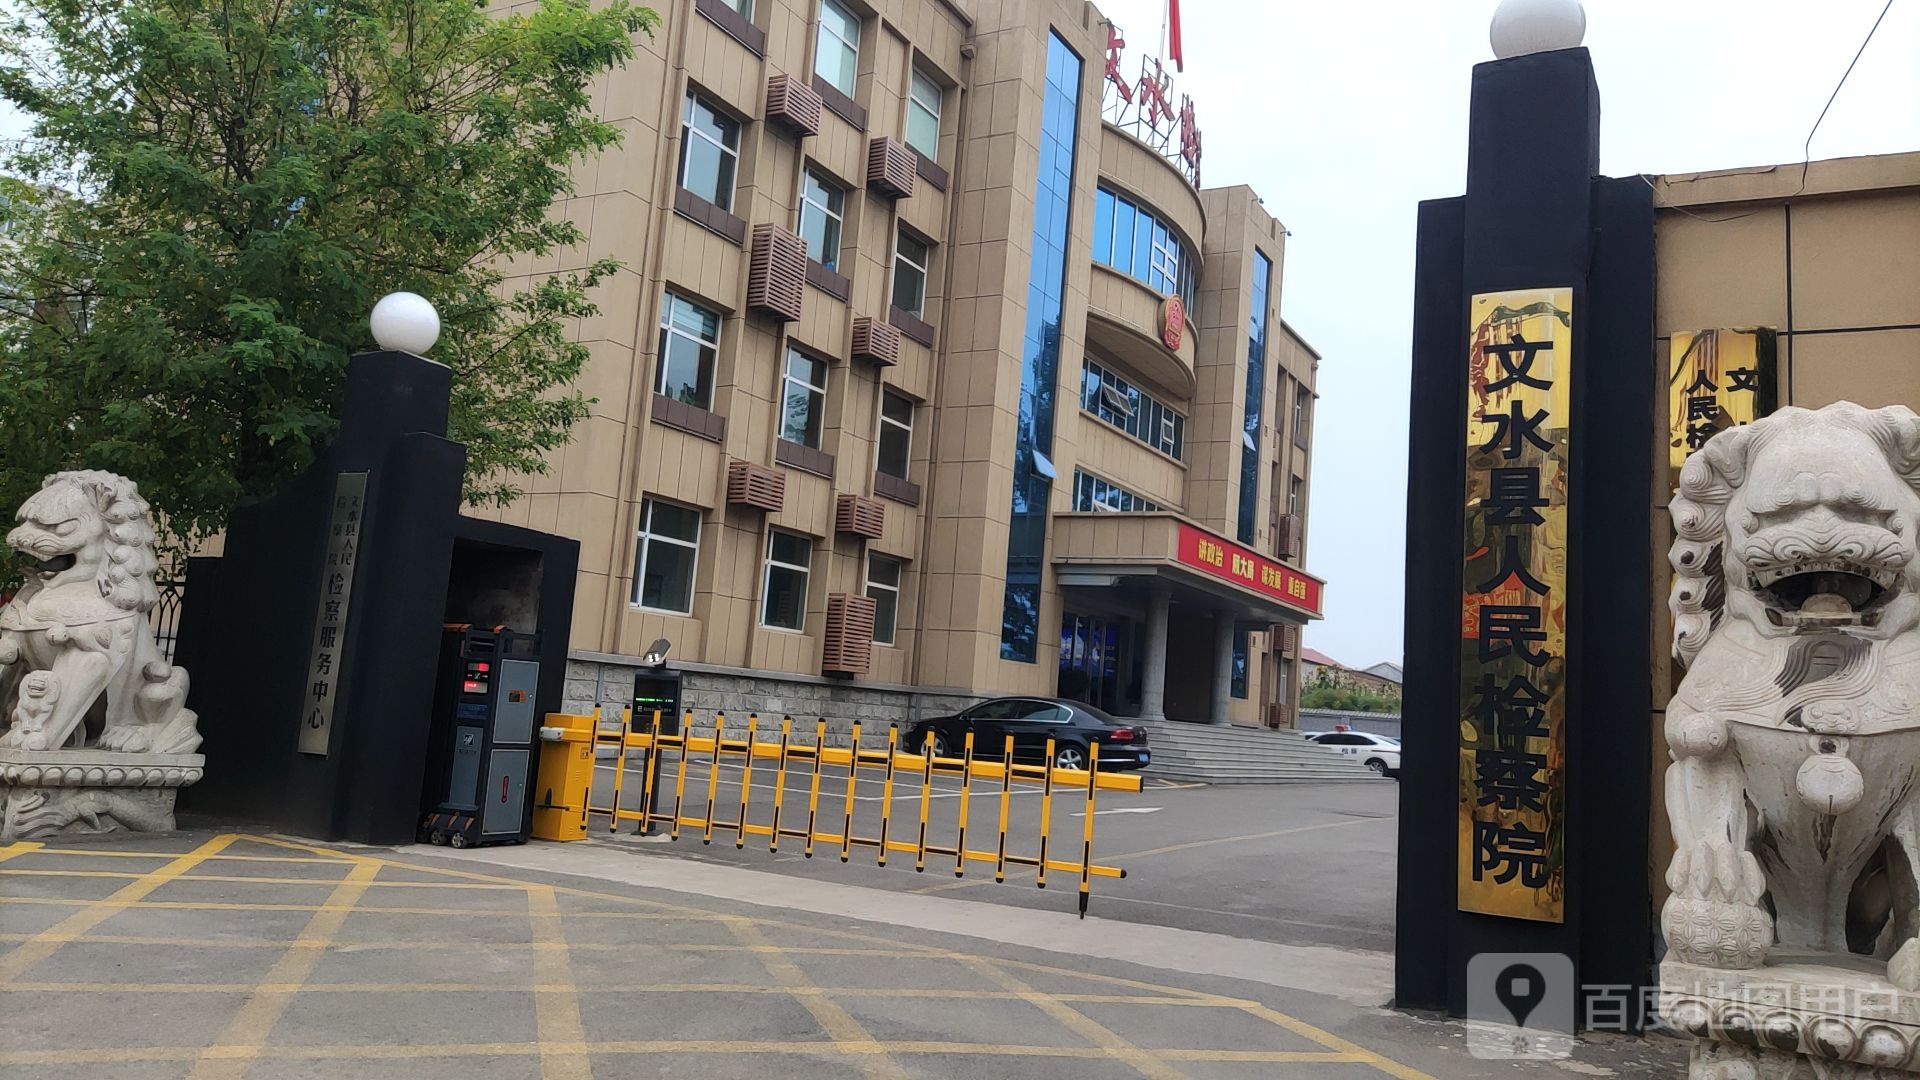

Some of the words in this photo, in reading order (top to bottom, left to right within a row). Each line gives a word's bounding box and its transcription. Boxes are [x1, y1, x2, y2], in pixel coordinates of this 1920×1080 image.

[1686, 370, 1719, 459] 人民检
[340, 495, 359, 566] 文水县人民
[1198, 538, 1224, 568] 讲政治
[1231, 553, 1255, 581] 顾大局
[307, 572, 345, 730] 检察服务中心
[1472, 335, 1554, 888] 文水县人民检察院
